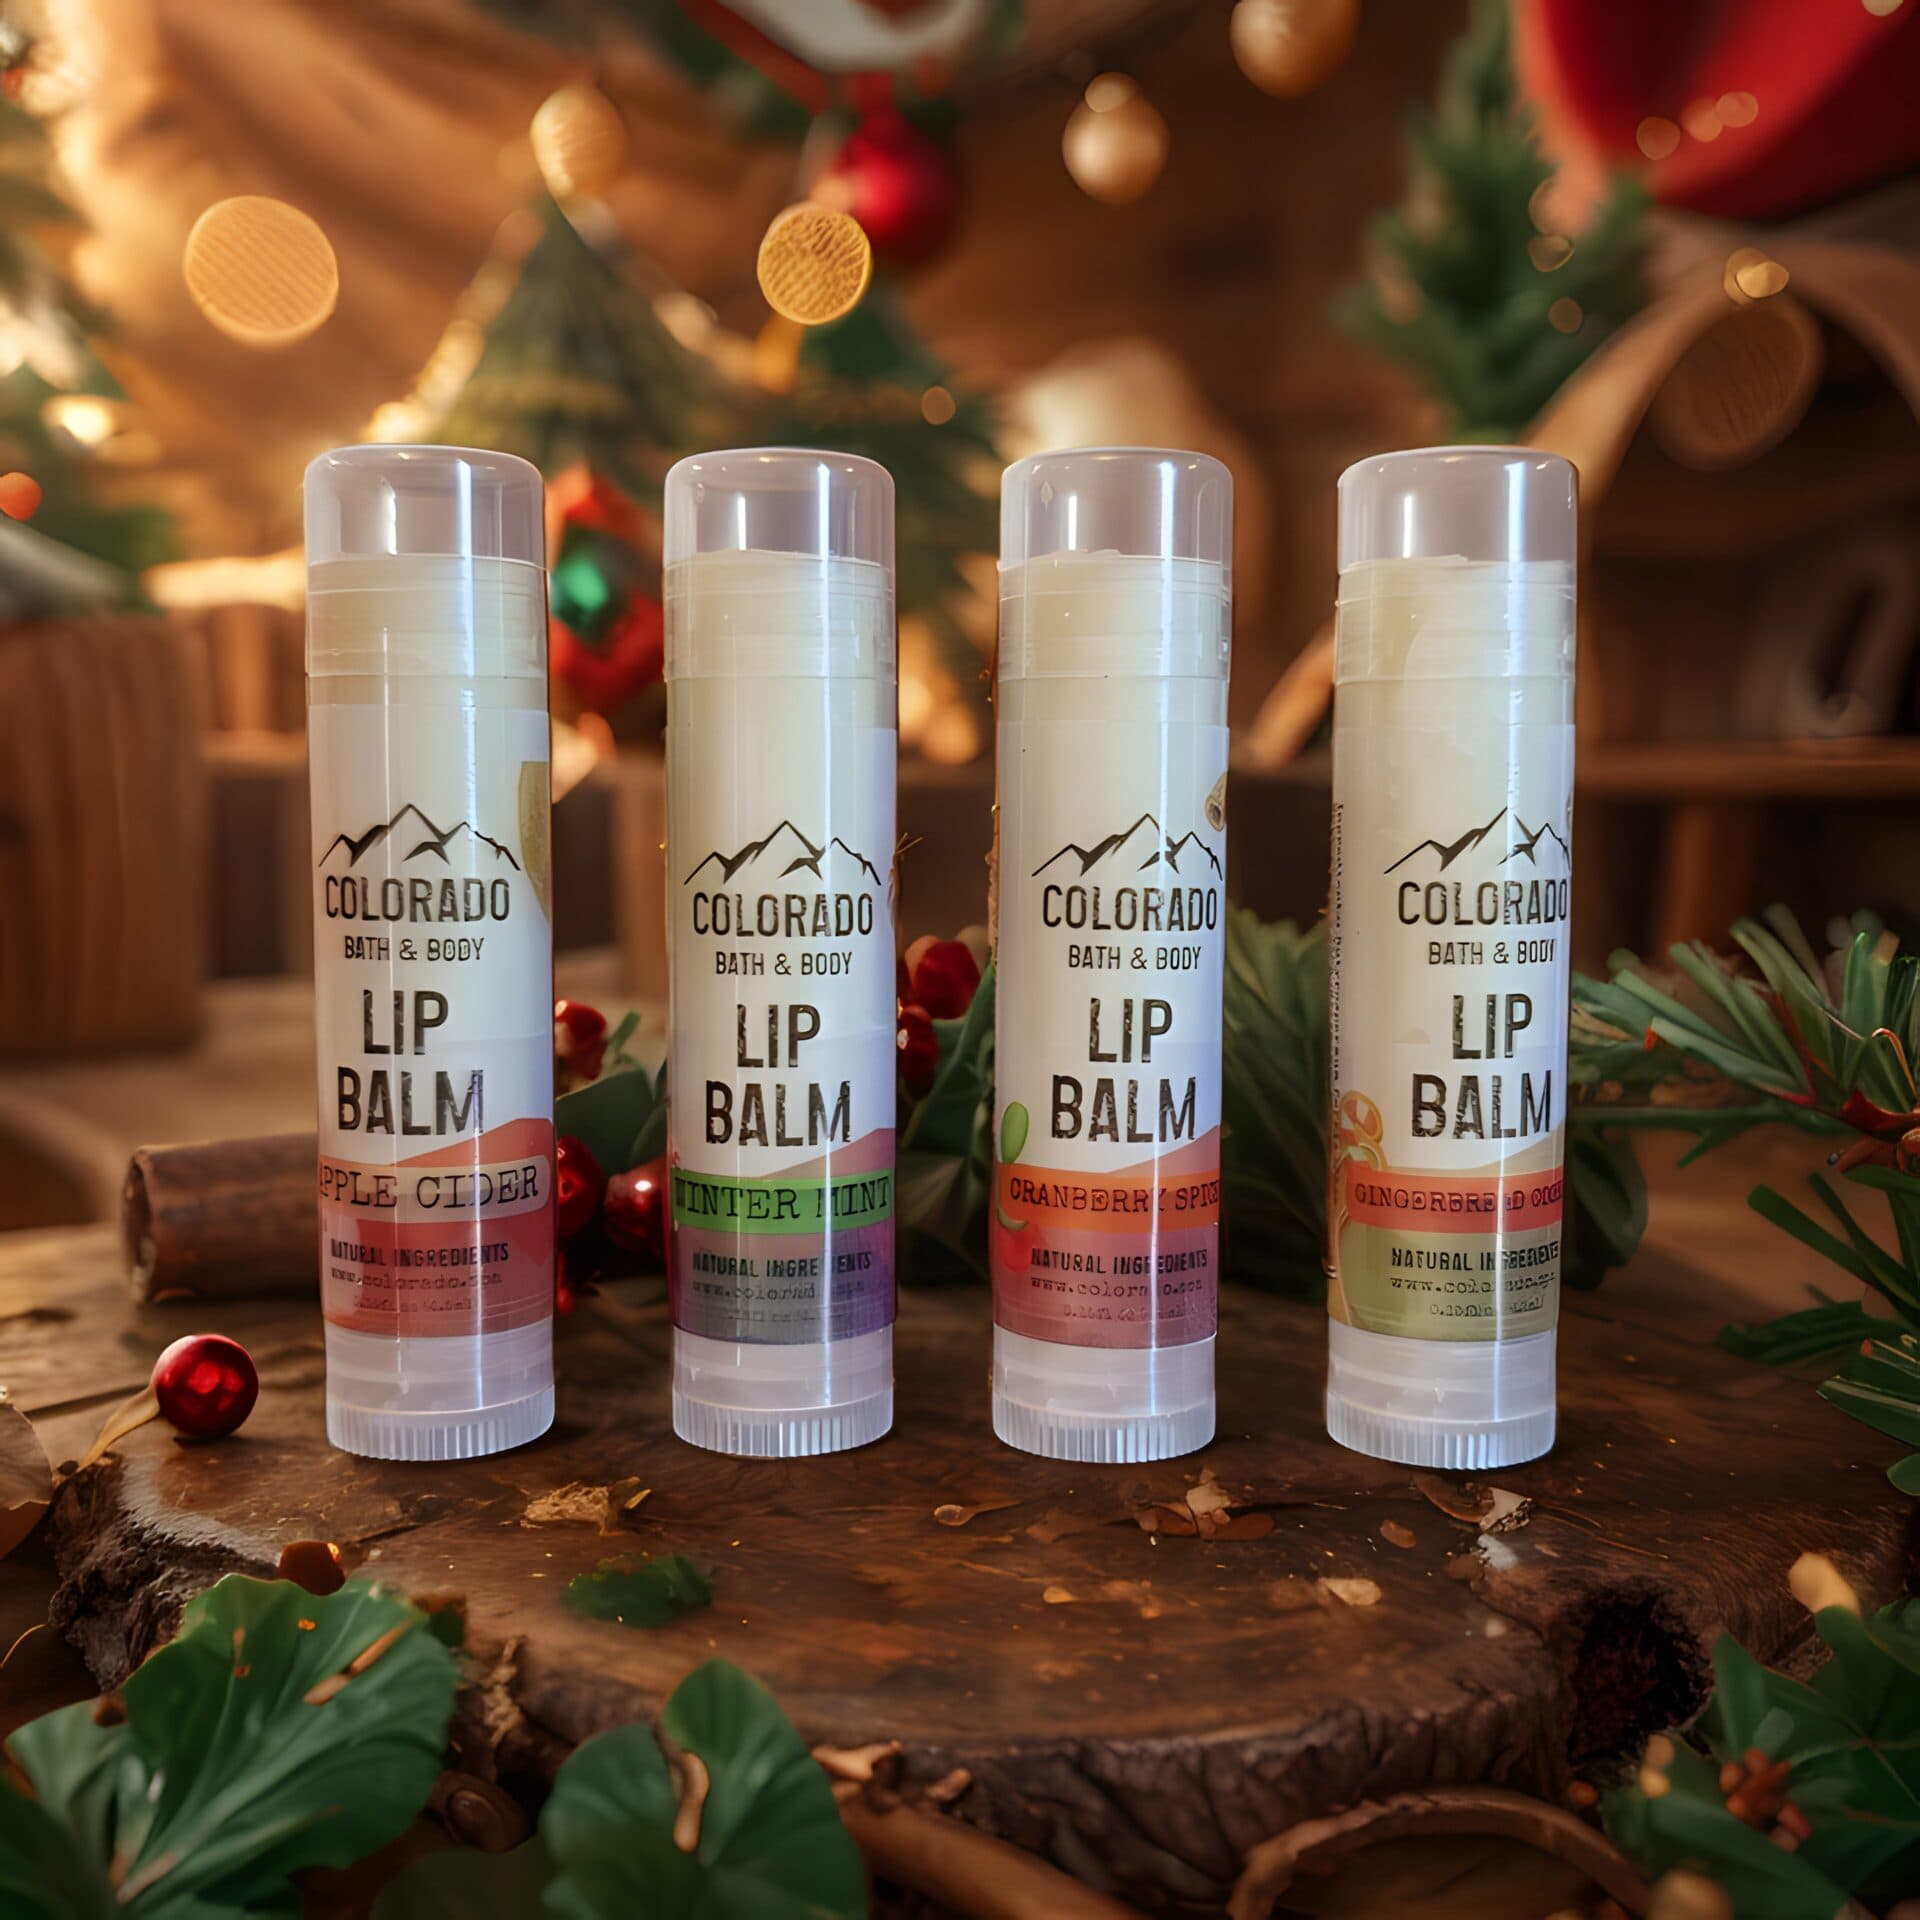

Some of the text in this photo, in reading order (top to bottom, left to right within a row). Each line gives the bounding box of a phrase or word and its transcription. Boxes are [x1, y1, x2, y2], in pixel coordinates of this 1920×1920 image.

[326, 875, 510, 922] COLORADO
[693, 891, 873, 937] COLORADO
[1042, 884, 1217, 931] COLORADO
[1398, 878, 1567, 925] COLORADO
[344, 935, 485, 961] BATH & BODY
[716, 951, 852, 975] BATH & BODY
[1068, 944, 1202, 970] BATH & BODY
[1428, 941, 1484, 965] BATH
[1493, 942, 1510, 964] &
[363, 989, 449, 1055] LIP
[737, 1004, 821, 1068] LIP
[1089, 997, 1173, 1063] LIP
[1452, 993, 1533, 1059] LIP
[337, 1066, 484, 1135] BALM
[706, 1080, 851, 1147] BALM
[1051, 1074, 1196, 1143] BALM
[1411, 1069, 1552, 1139] BALM
[320, 1165, 539, 1209] PPLE CIDER
[815, 1176, 889, 1218] MINT
[692, 1251, 872, 1277] NATURAL INGREIENTS
[1031, 1248, 1107, 1274] NATURAL
[1391, 1247, 1473, 1271] NATURAL
